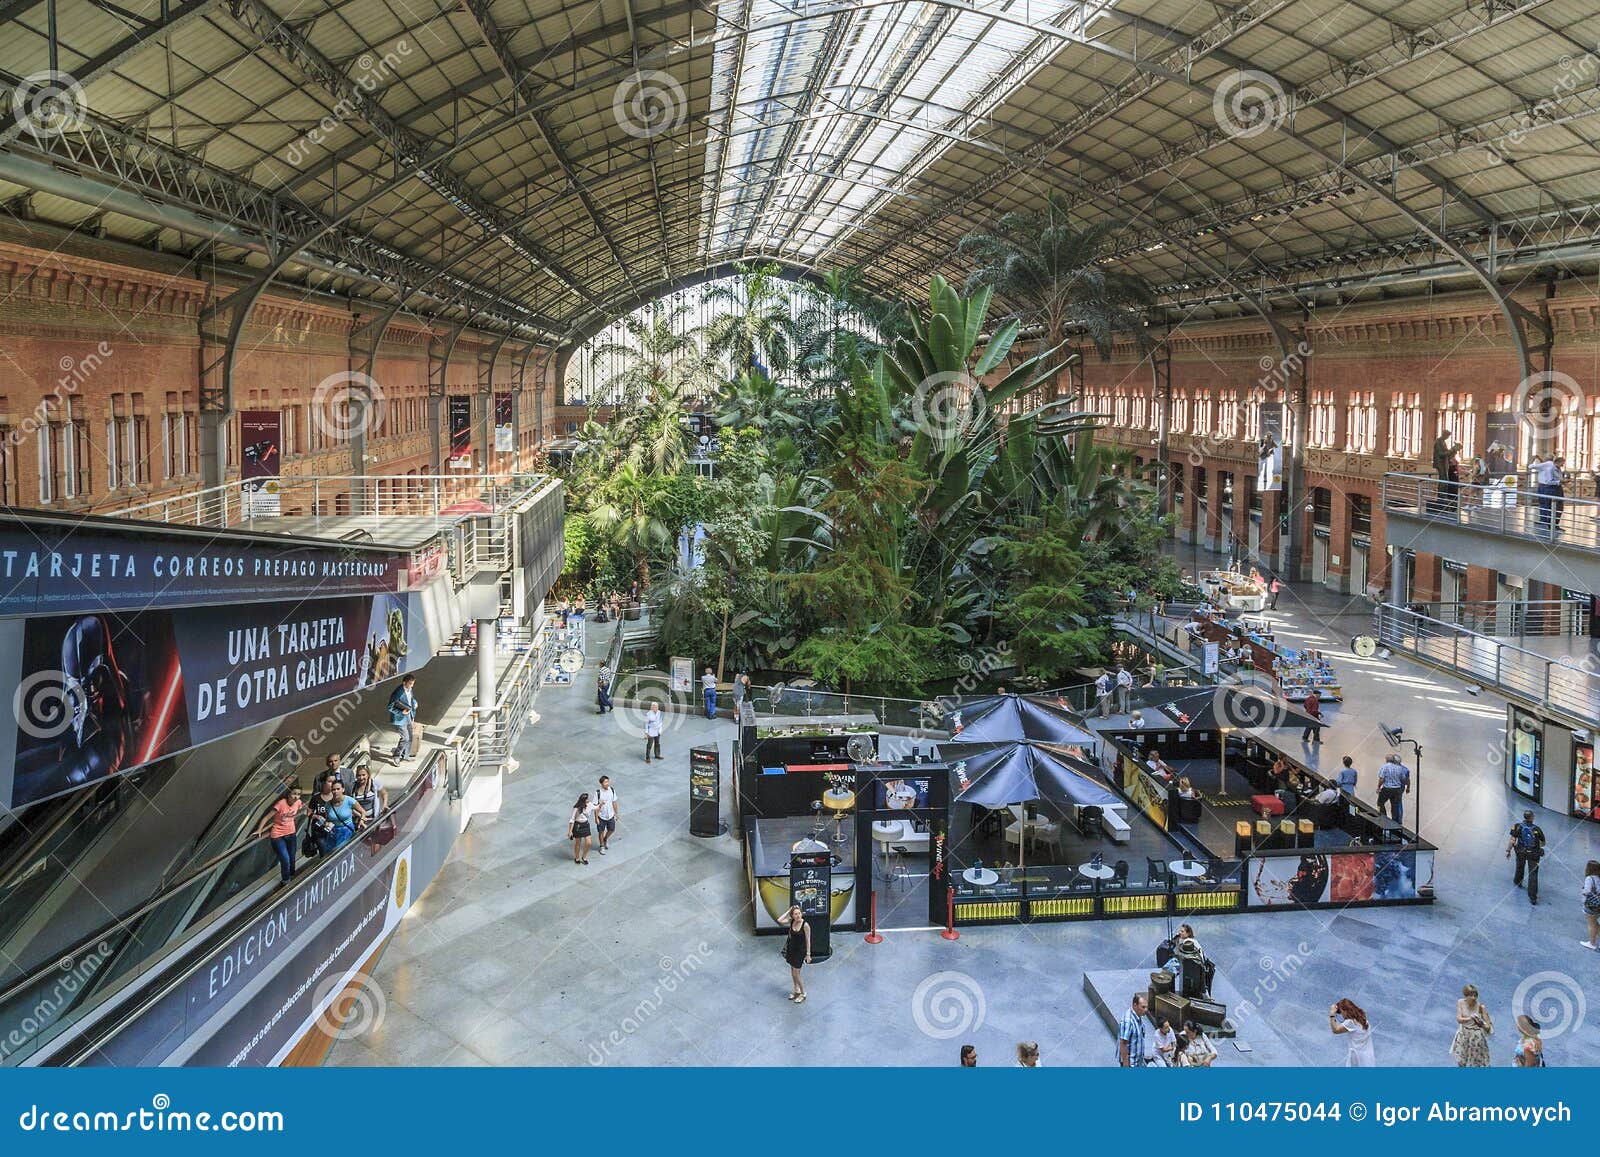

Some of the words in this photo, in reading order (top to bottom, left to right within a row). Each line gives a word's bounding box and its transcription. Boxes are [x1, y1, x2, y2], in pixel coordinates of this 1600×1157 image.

[3, 551, 136, 577] TARJETA
[153, 555, 244, 577] CORREOS
[254, 558, 315, 577] PREPAGO
[228, 626, 270, 665] UNA
[278, 617, 344, 656] TARJETA
[197, 678, 228, 721] DE
[237, 665, 288, 709] OTRA
[295, 649, 357, 691] GALAXIA
[209, 907, 288, 999] EDICIÓN
[295, 852, 355, 922] LIMITADA
